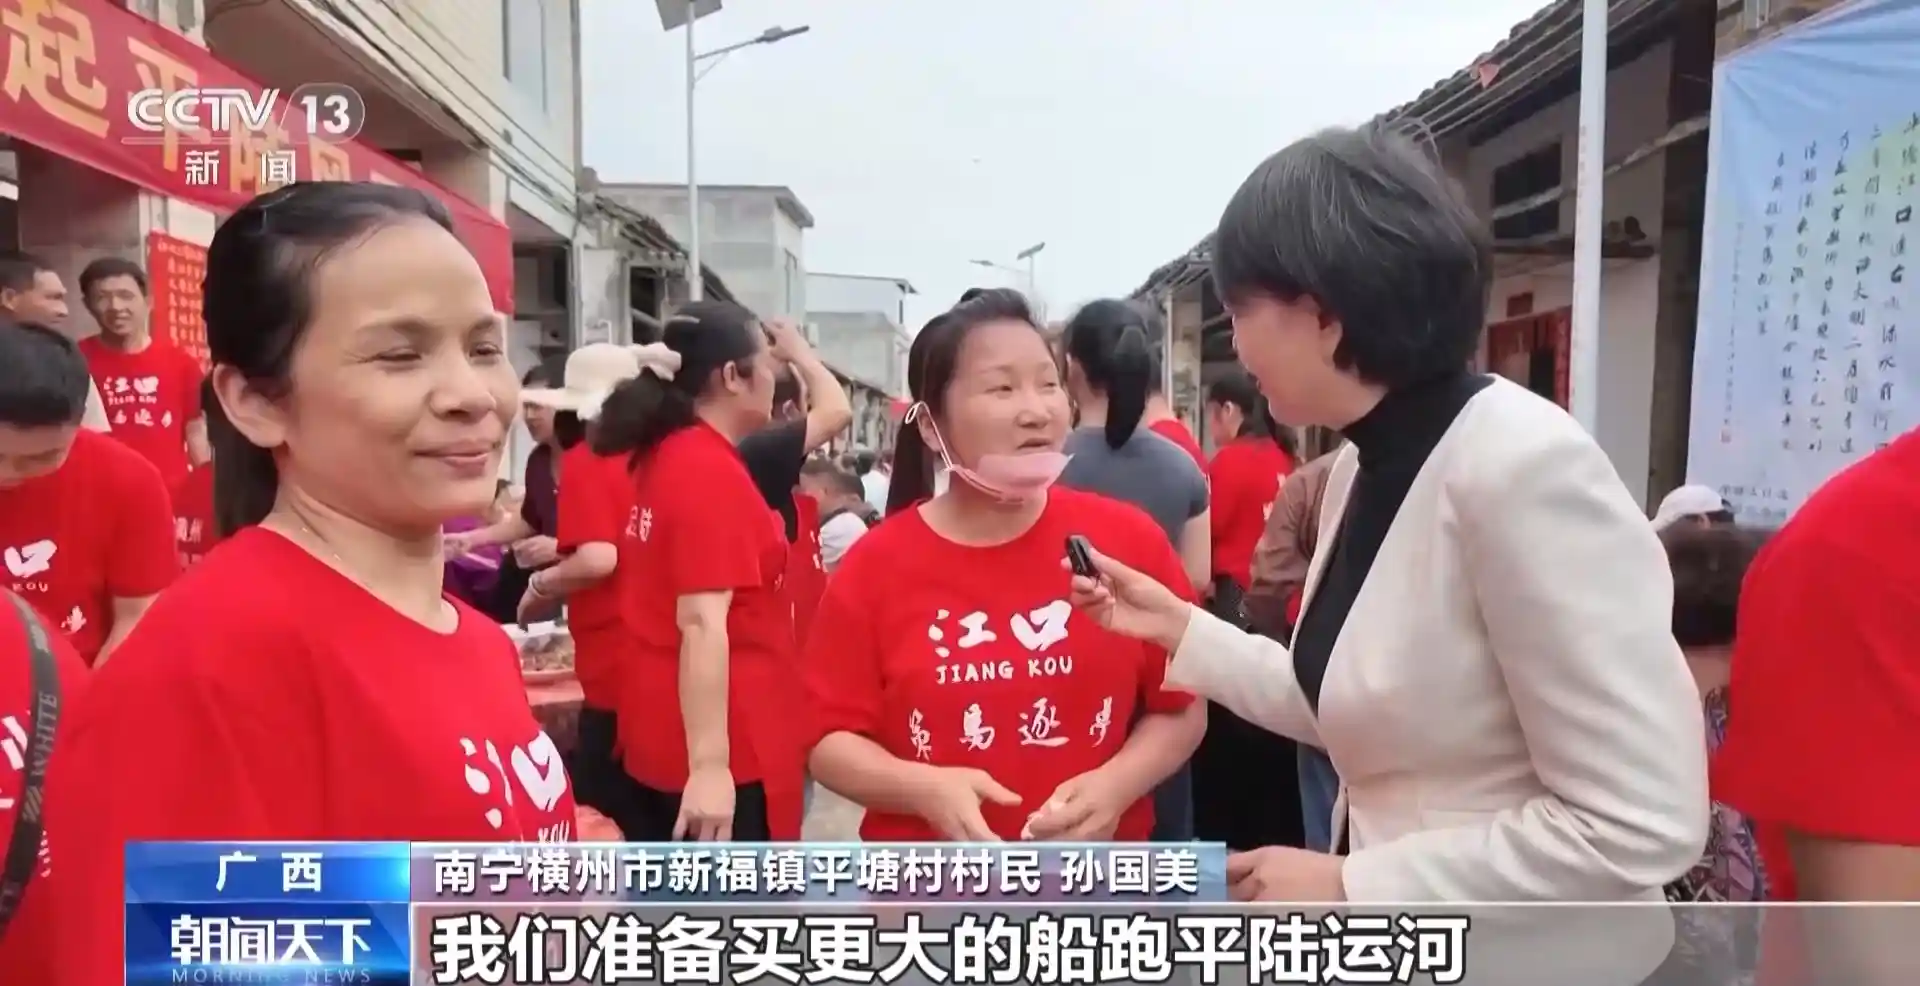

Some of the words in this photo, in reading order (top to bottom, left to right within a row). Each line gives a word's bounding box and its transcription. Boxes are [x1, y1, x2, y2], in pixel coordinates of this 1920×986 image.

[928, 600, 1073, 659] 江口
[935, 660, 1014, 685] JIANG
[1028, 655, 1073, 678] KOU
